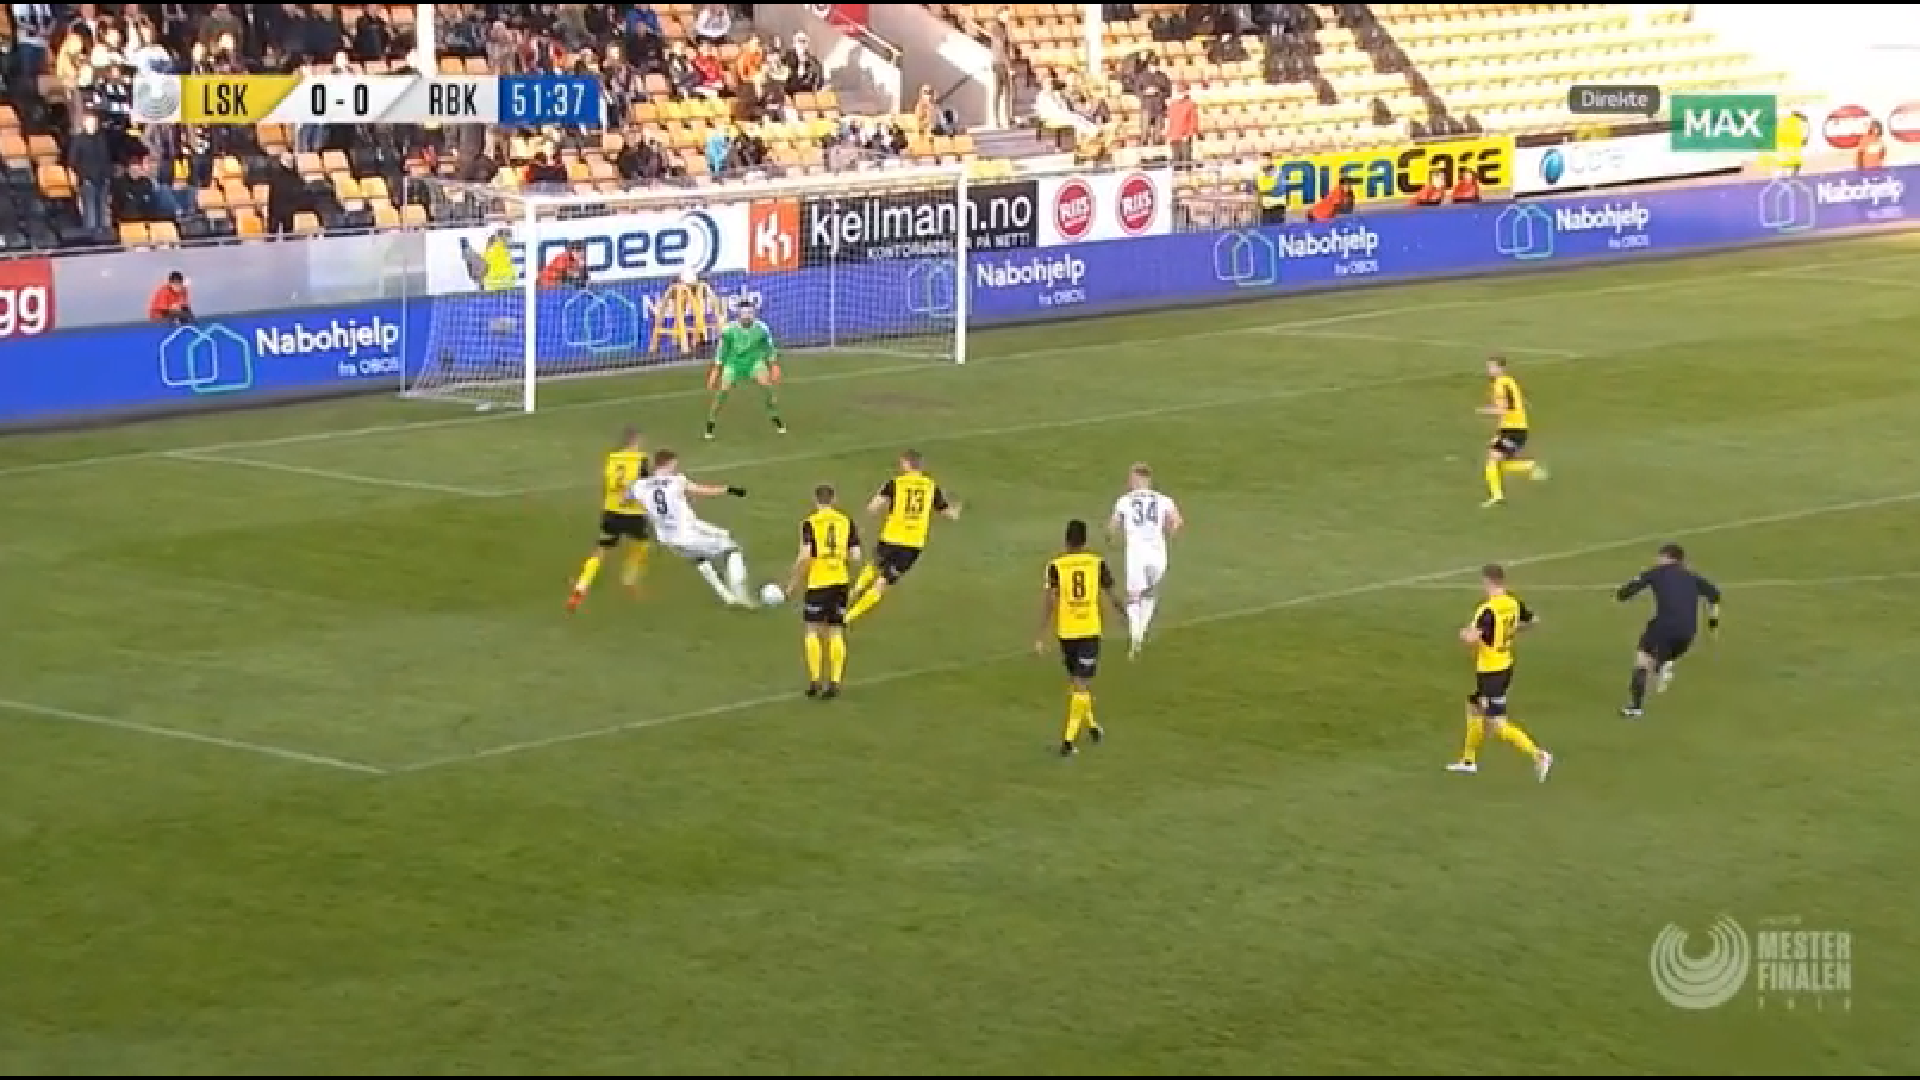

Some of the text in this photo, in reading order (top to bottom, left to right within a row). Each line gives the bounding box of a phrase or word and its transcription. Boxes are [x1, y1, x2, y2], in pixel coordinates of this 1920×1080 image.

[1278, 226, 1380, 259] Nabohjelp
[976, 253, 1085, 287] Nabohjelp
[255, 316, 399, 357] Nabohjelp
[653, 488, 668, 515] 9
[904, 487, 925, 512] 13
[1131, 498, 1159, 527] 34
[824, 521, 837, 558] 4
[1071, 570, 1087, 598] 8
